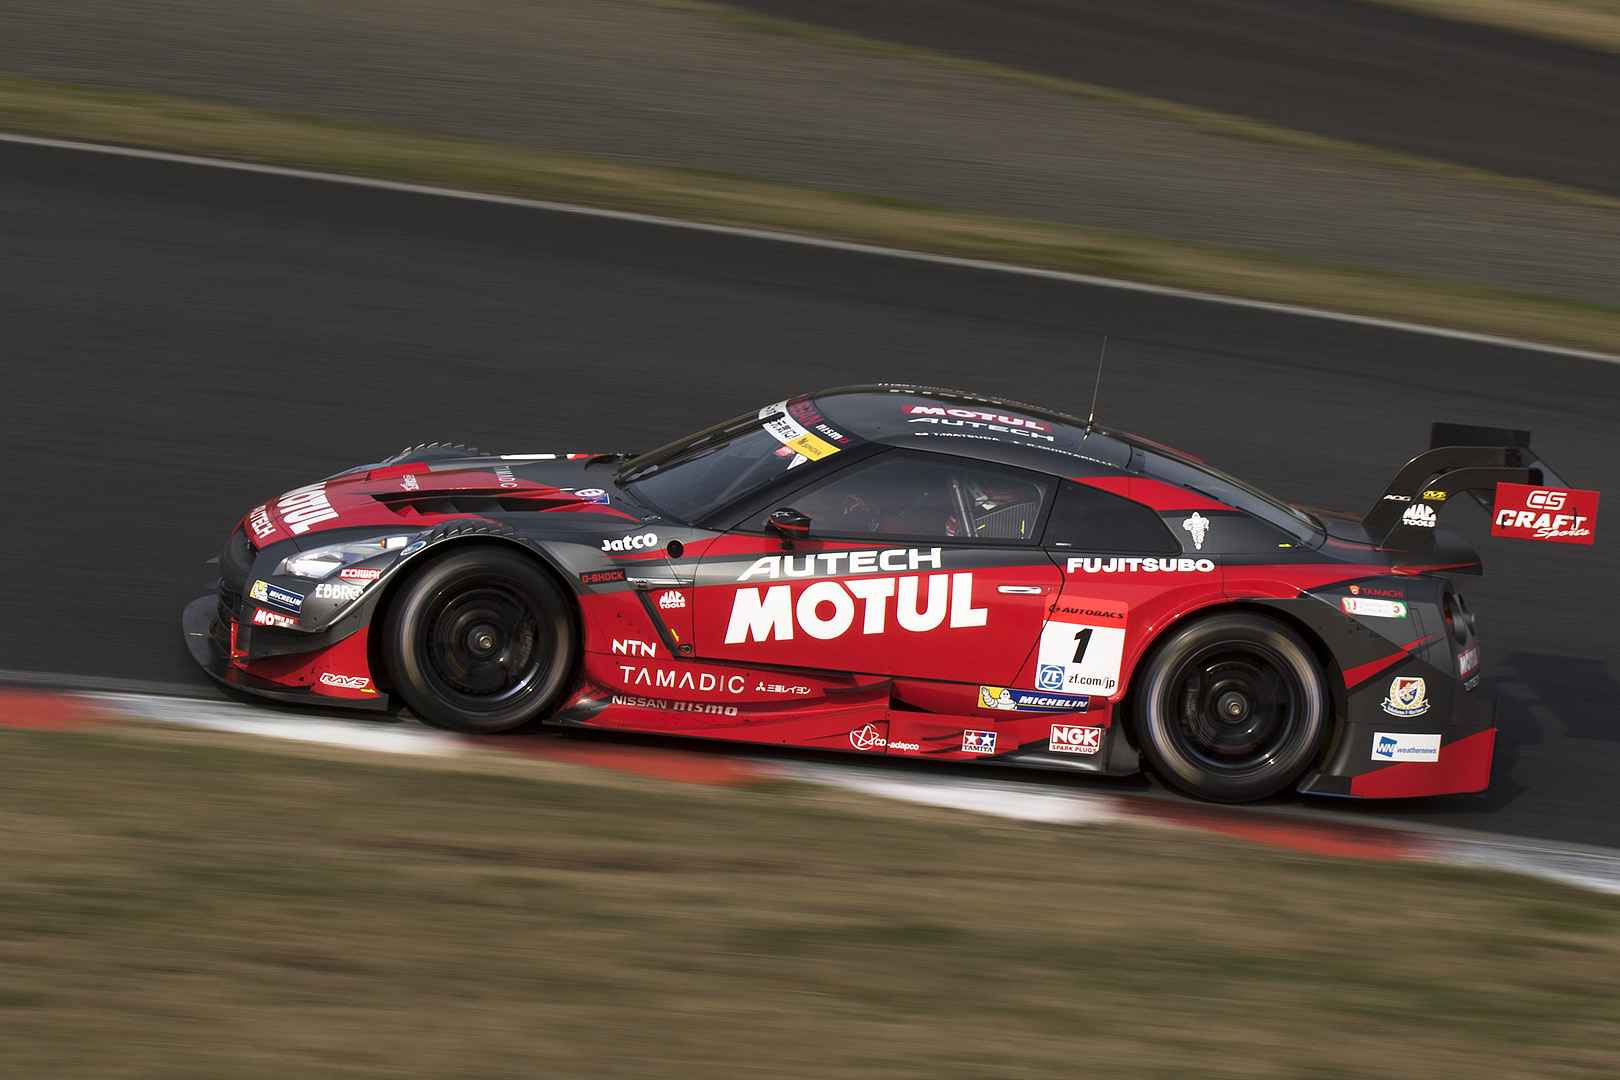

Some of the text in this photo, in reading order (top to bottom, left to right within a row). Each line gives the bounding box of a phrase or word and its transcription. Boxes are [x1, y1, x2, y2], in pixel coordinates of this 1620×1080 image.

[911, 406, 1045, 431] MOTUL
[815, 423, 850, 444] nismo
[907, 418, 1054, 442] AUTECH
[277, 481, 339, 535] MOTUL
[1402, 503, 1437, 520] MAC
[250, 505, 276, 539] AUTECH
[1402, 519, 1436, 528] TOOLS
[1495, 509, 1587, 531] CRAFT
[1532, 527, 1591, 539] Sports
[736, 547, 942, 581] AUTECH
[1066, 557, 1215, 573] FUJITSUBO
[582, 571, 624, 584] G-SHOCK
[269, 588, 304, 607] MICHELIN
[659, 590, 685, 604] MAC
[1362, 587, 1404, 598] TAMACHI
[724, 572, 988, 644] MOTUL
[1062, 607, 1125, 620] AUTOBACS
[612, 638, 657, 658] NTN
[1071, 628, 1094, 664] 1
[320, 673, 369, 687] RAYS
[619, 665, 745, 694] TAMADIC
[1042, 671, 1116, 689] ZF zf.com/jp
[611, 695, 738, 716] NISSAN nismo
[1018, 695, 1088, 708] MICHELIN
[1052, 728, 1098, 747] NGK
[963, 745, 993, 753] TAMIYA
[1074, 746, 1098, 754] PLUGS
